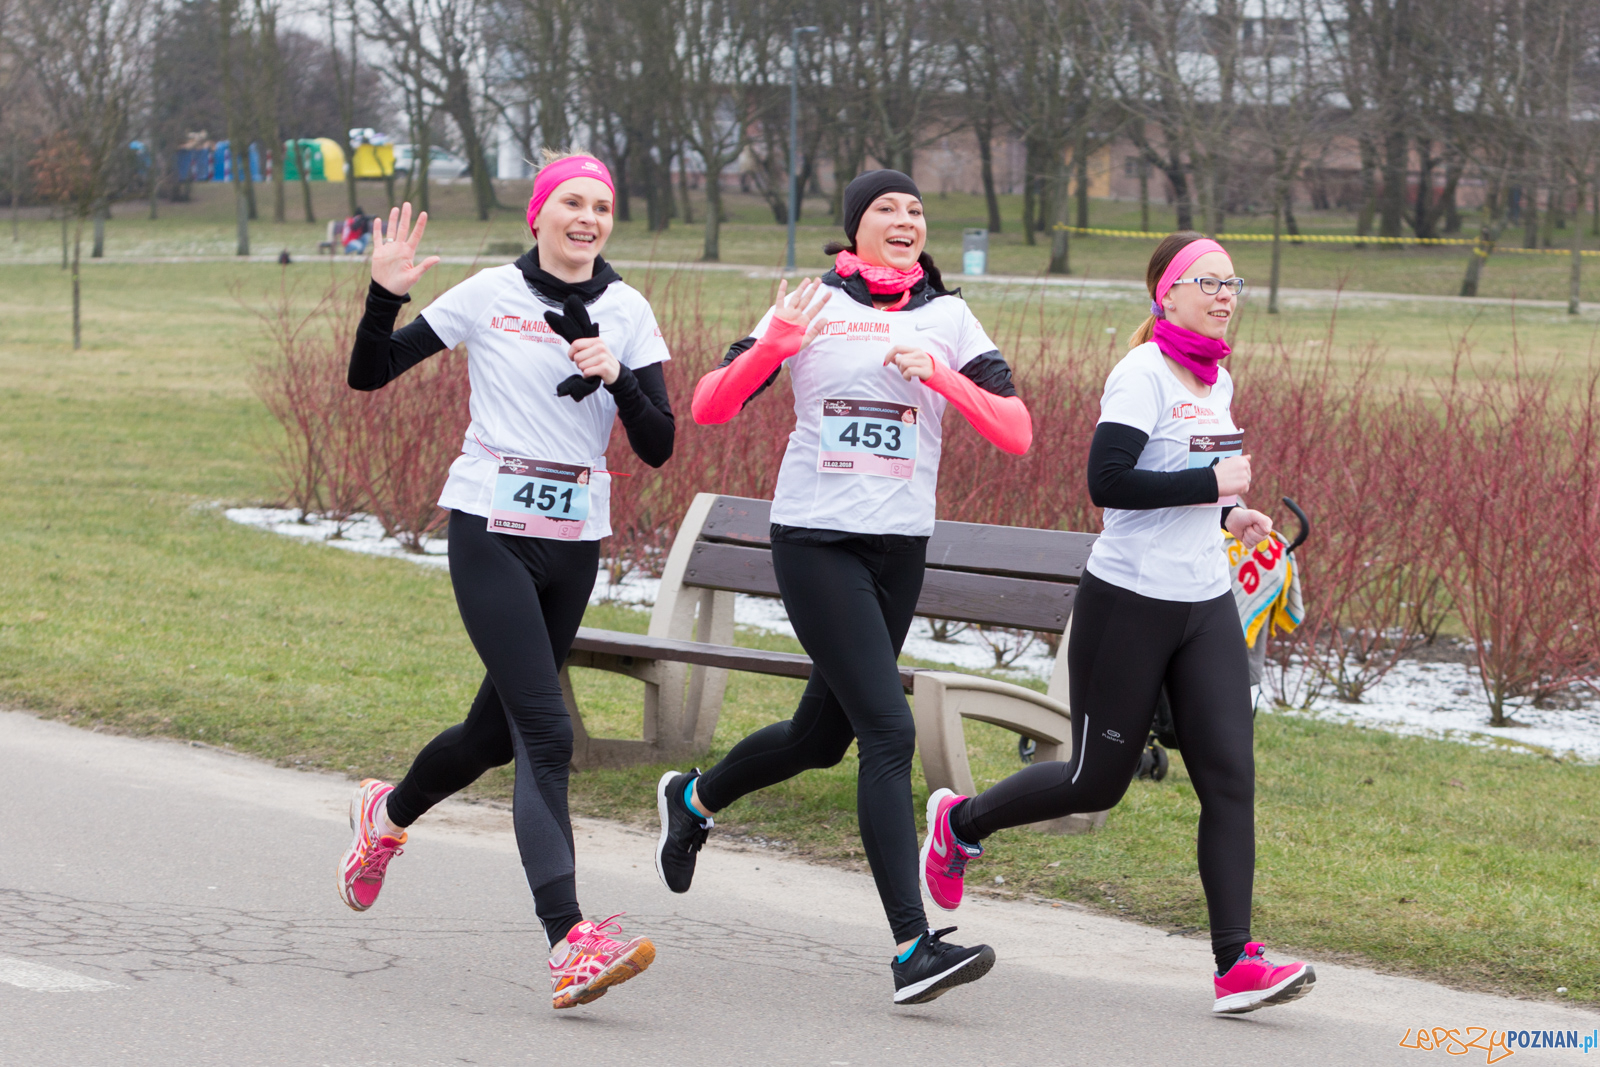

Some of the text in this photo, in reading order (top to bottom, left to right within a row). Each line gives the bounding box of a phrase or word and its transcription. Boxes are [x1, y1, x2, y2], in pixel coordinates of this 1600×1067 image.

[847, 322, 890, 334] AKADEMIA
[839, 422, 901, 451] 453
[513, 482, 573, 513] 451
[495, 520, 525, 529] 11.02.2018
